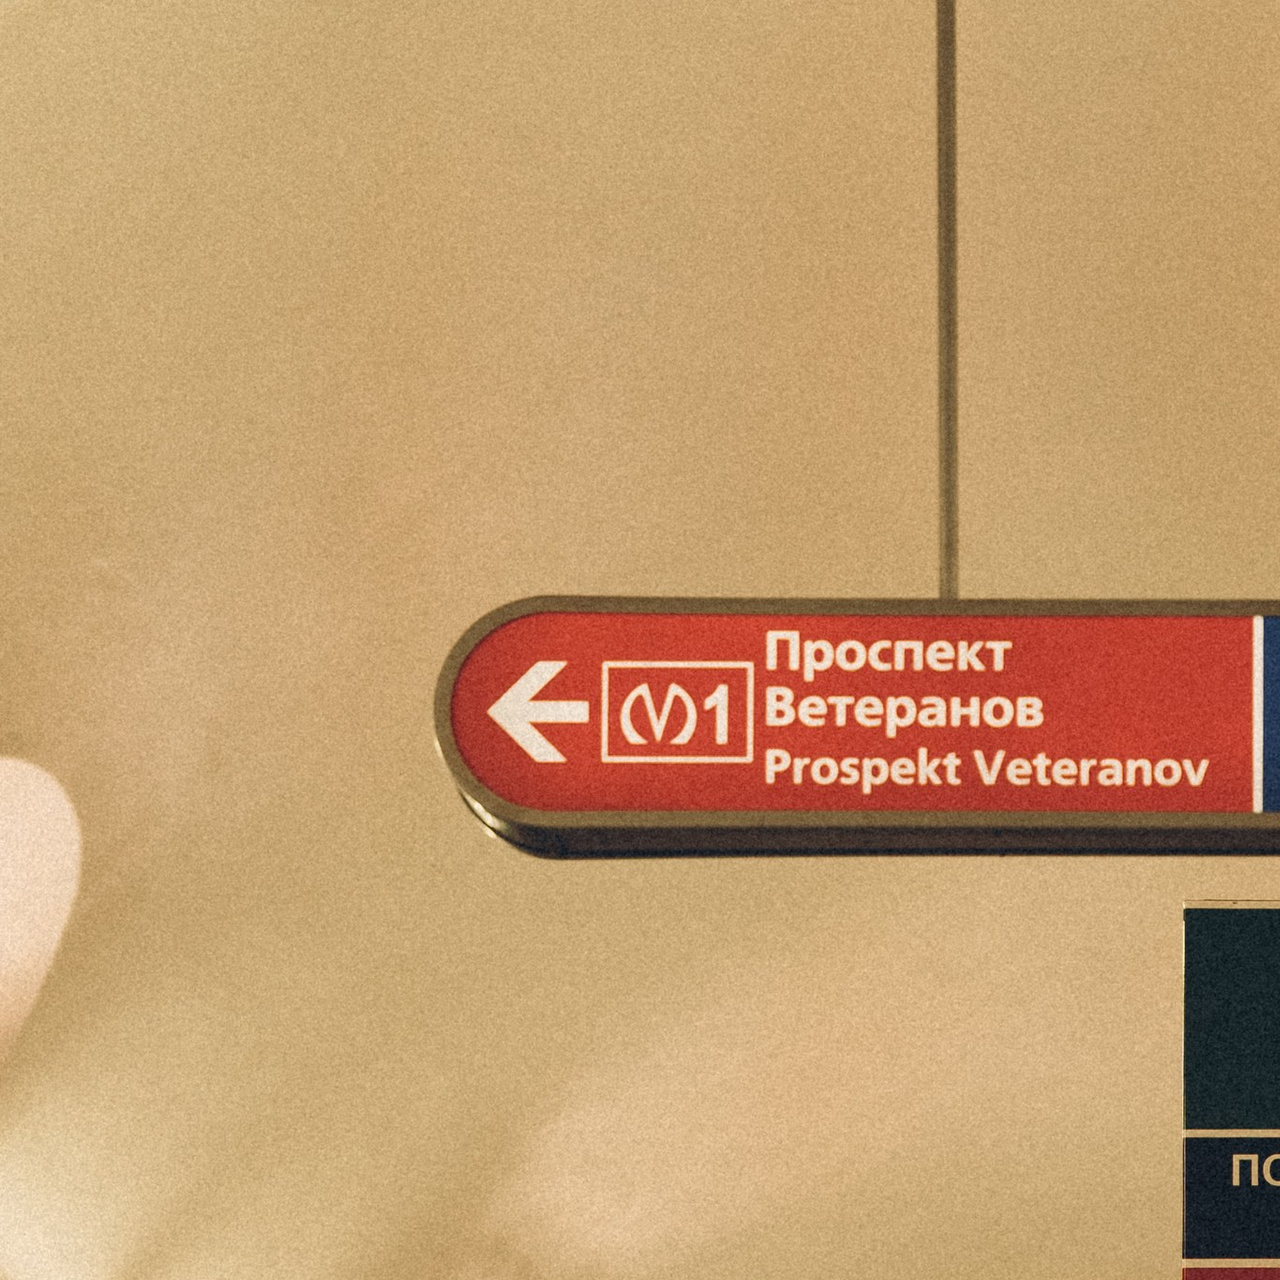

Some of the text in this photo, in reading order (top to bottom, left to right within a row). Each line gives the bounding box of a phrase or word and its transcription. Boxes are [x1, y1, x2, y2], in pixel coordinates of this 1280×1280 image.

[764, 629, 1013, 681] Проспект
[764, 688, 1044, 738] Ветеранов
[764, 748, 1209, 794] Prospekt Veteranov
